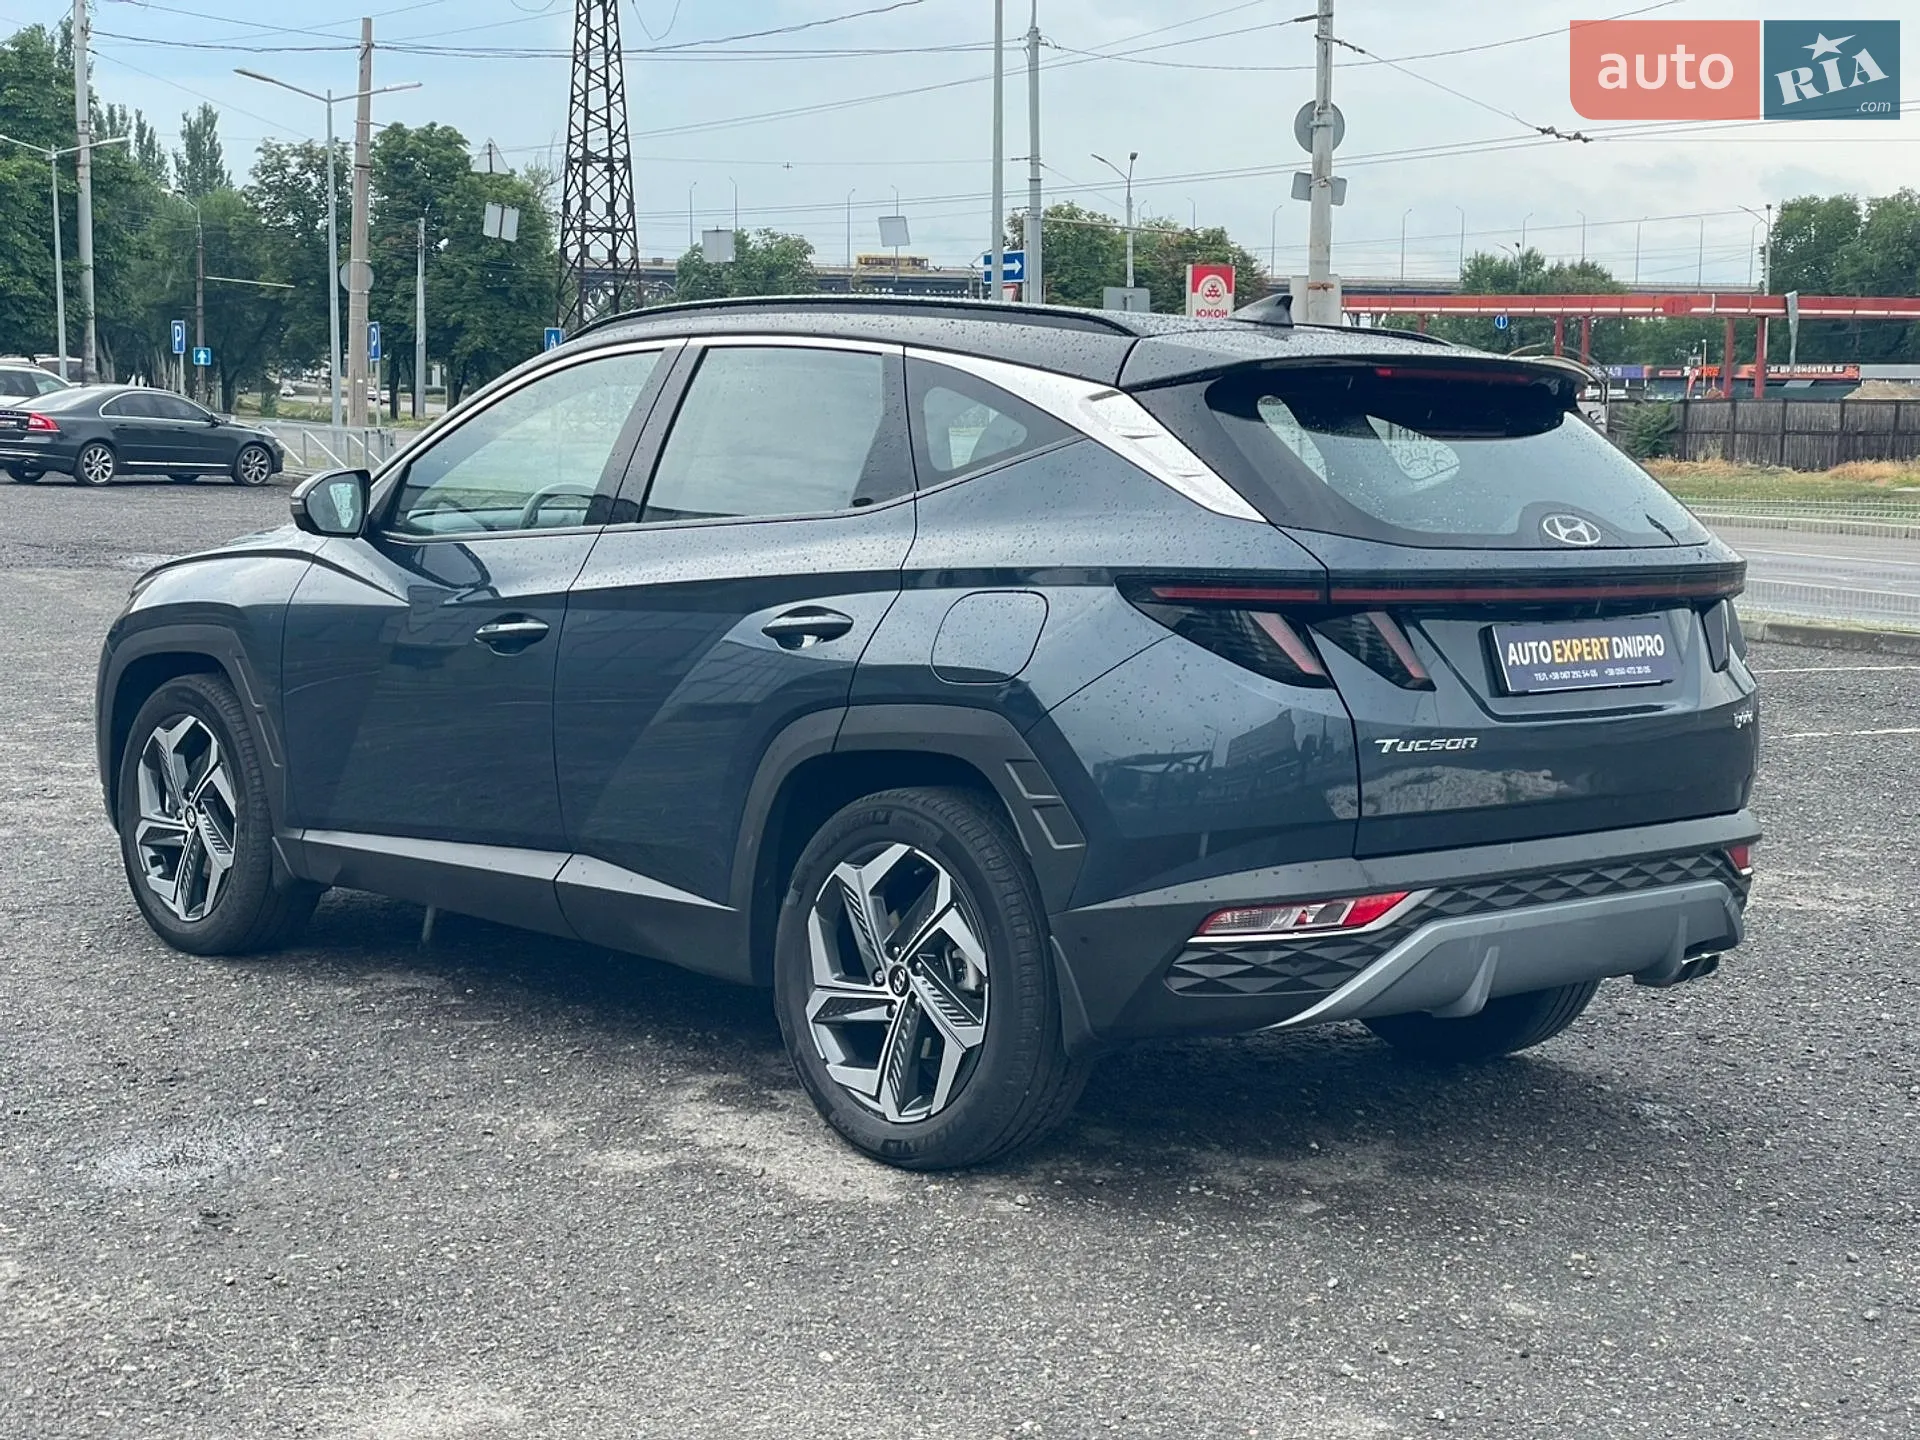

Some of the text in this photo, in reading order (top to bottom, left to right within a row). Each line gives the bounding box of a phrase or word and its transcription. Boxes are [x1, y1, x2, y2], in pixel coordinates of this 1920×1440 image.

[1196, 308, 1228, 318] ЮКОН
[174, 325, 182, 350] P
[1508, 634, 1665, 666] AUTO EXPERT DNIPRO
